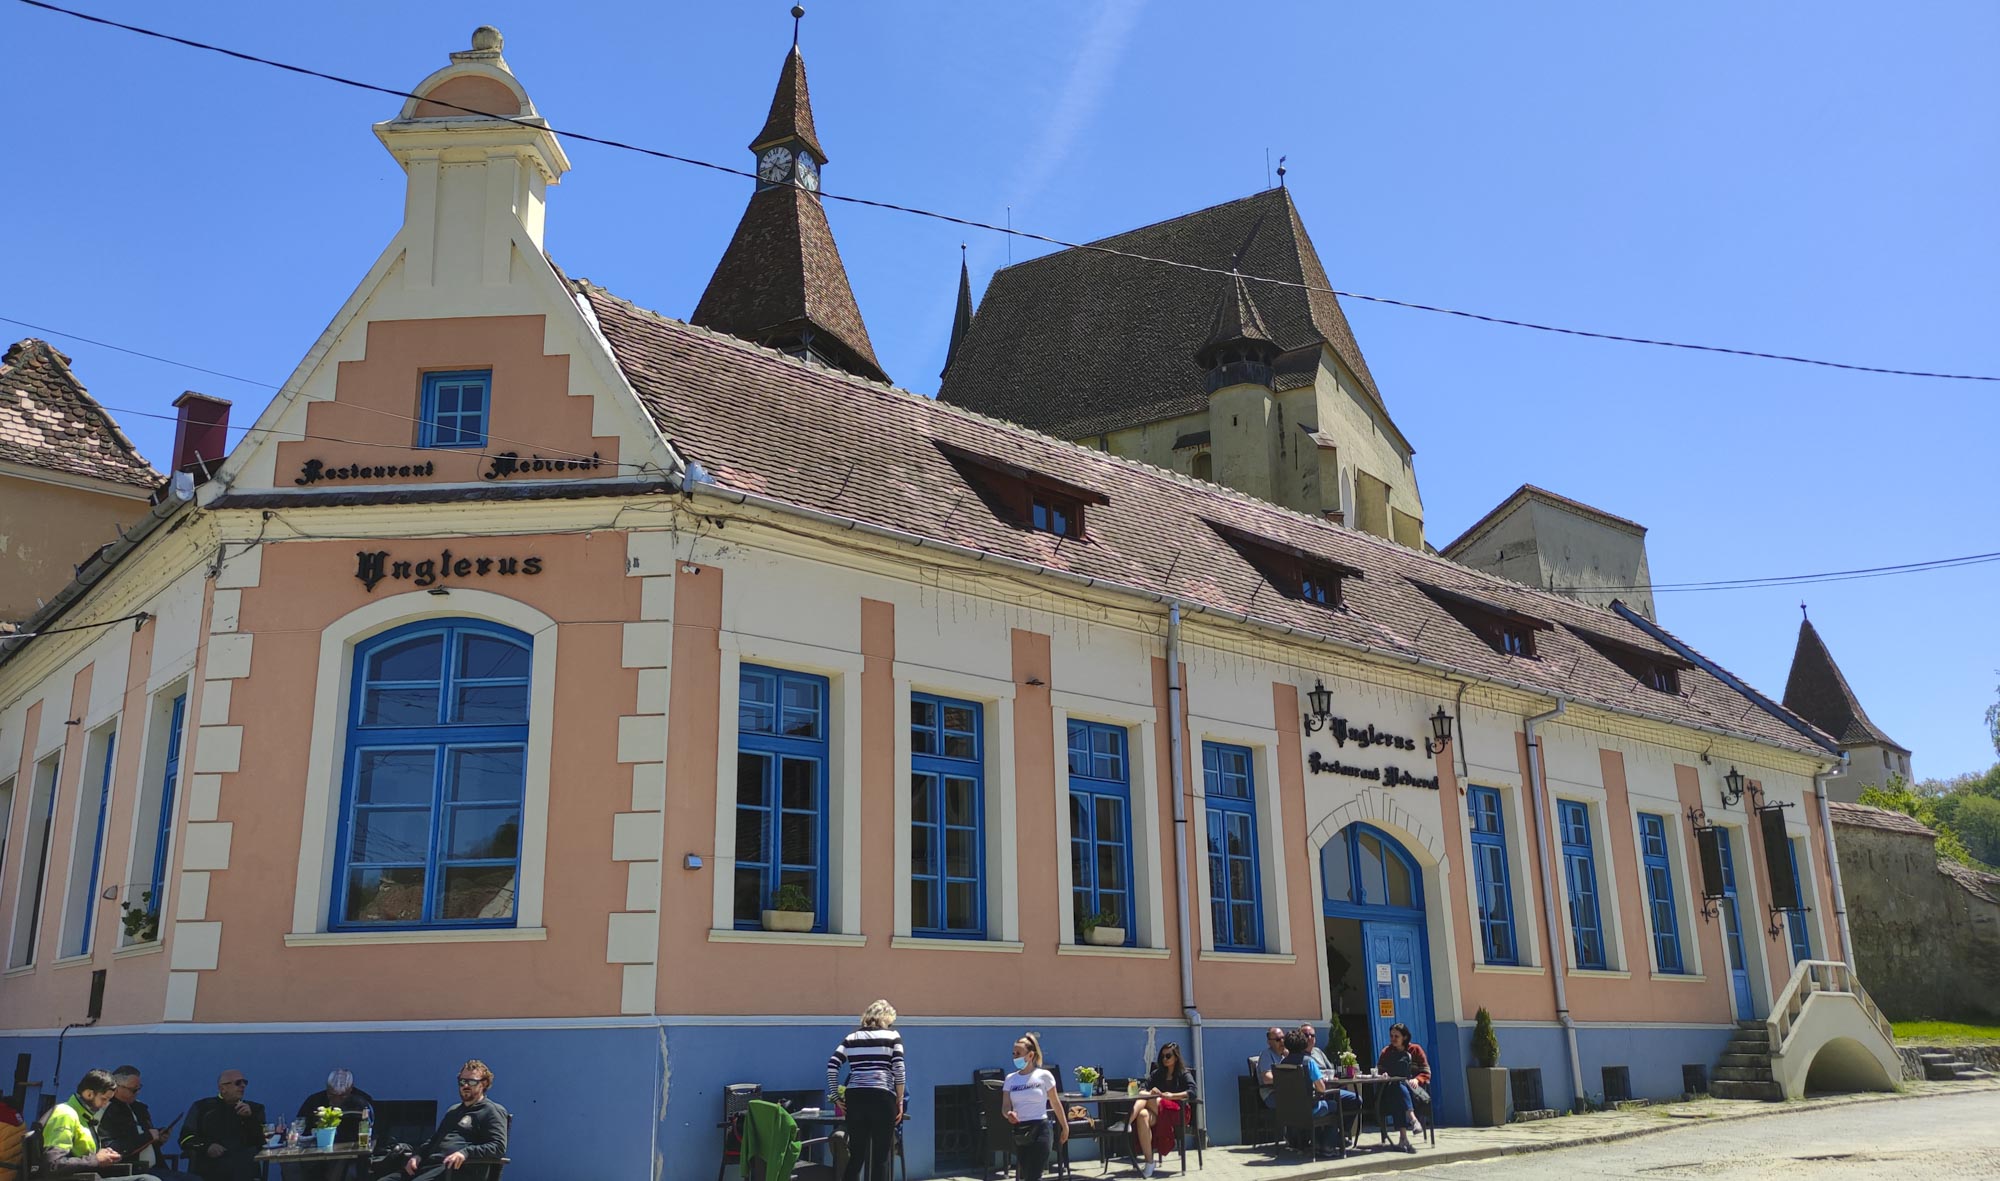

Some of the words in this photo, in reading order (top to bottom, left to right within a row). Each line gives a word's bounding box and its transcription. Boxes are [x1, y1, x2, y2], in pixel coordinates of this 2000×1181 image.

[295, 458, 434, 485] Restaurant
[485, 451, 600, 479] Medieval
[355, 549, 543, 592] Unglerus
[1329, 717, 1416, 750] Unglerus
[1308, 751, 1380, 780] Restaurant
[1382, 766, 1440, 790] Medieval
